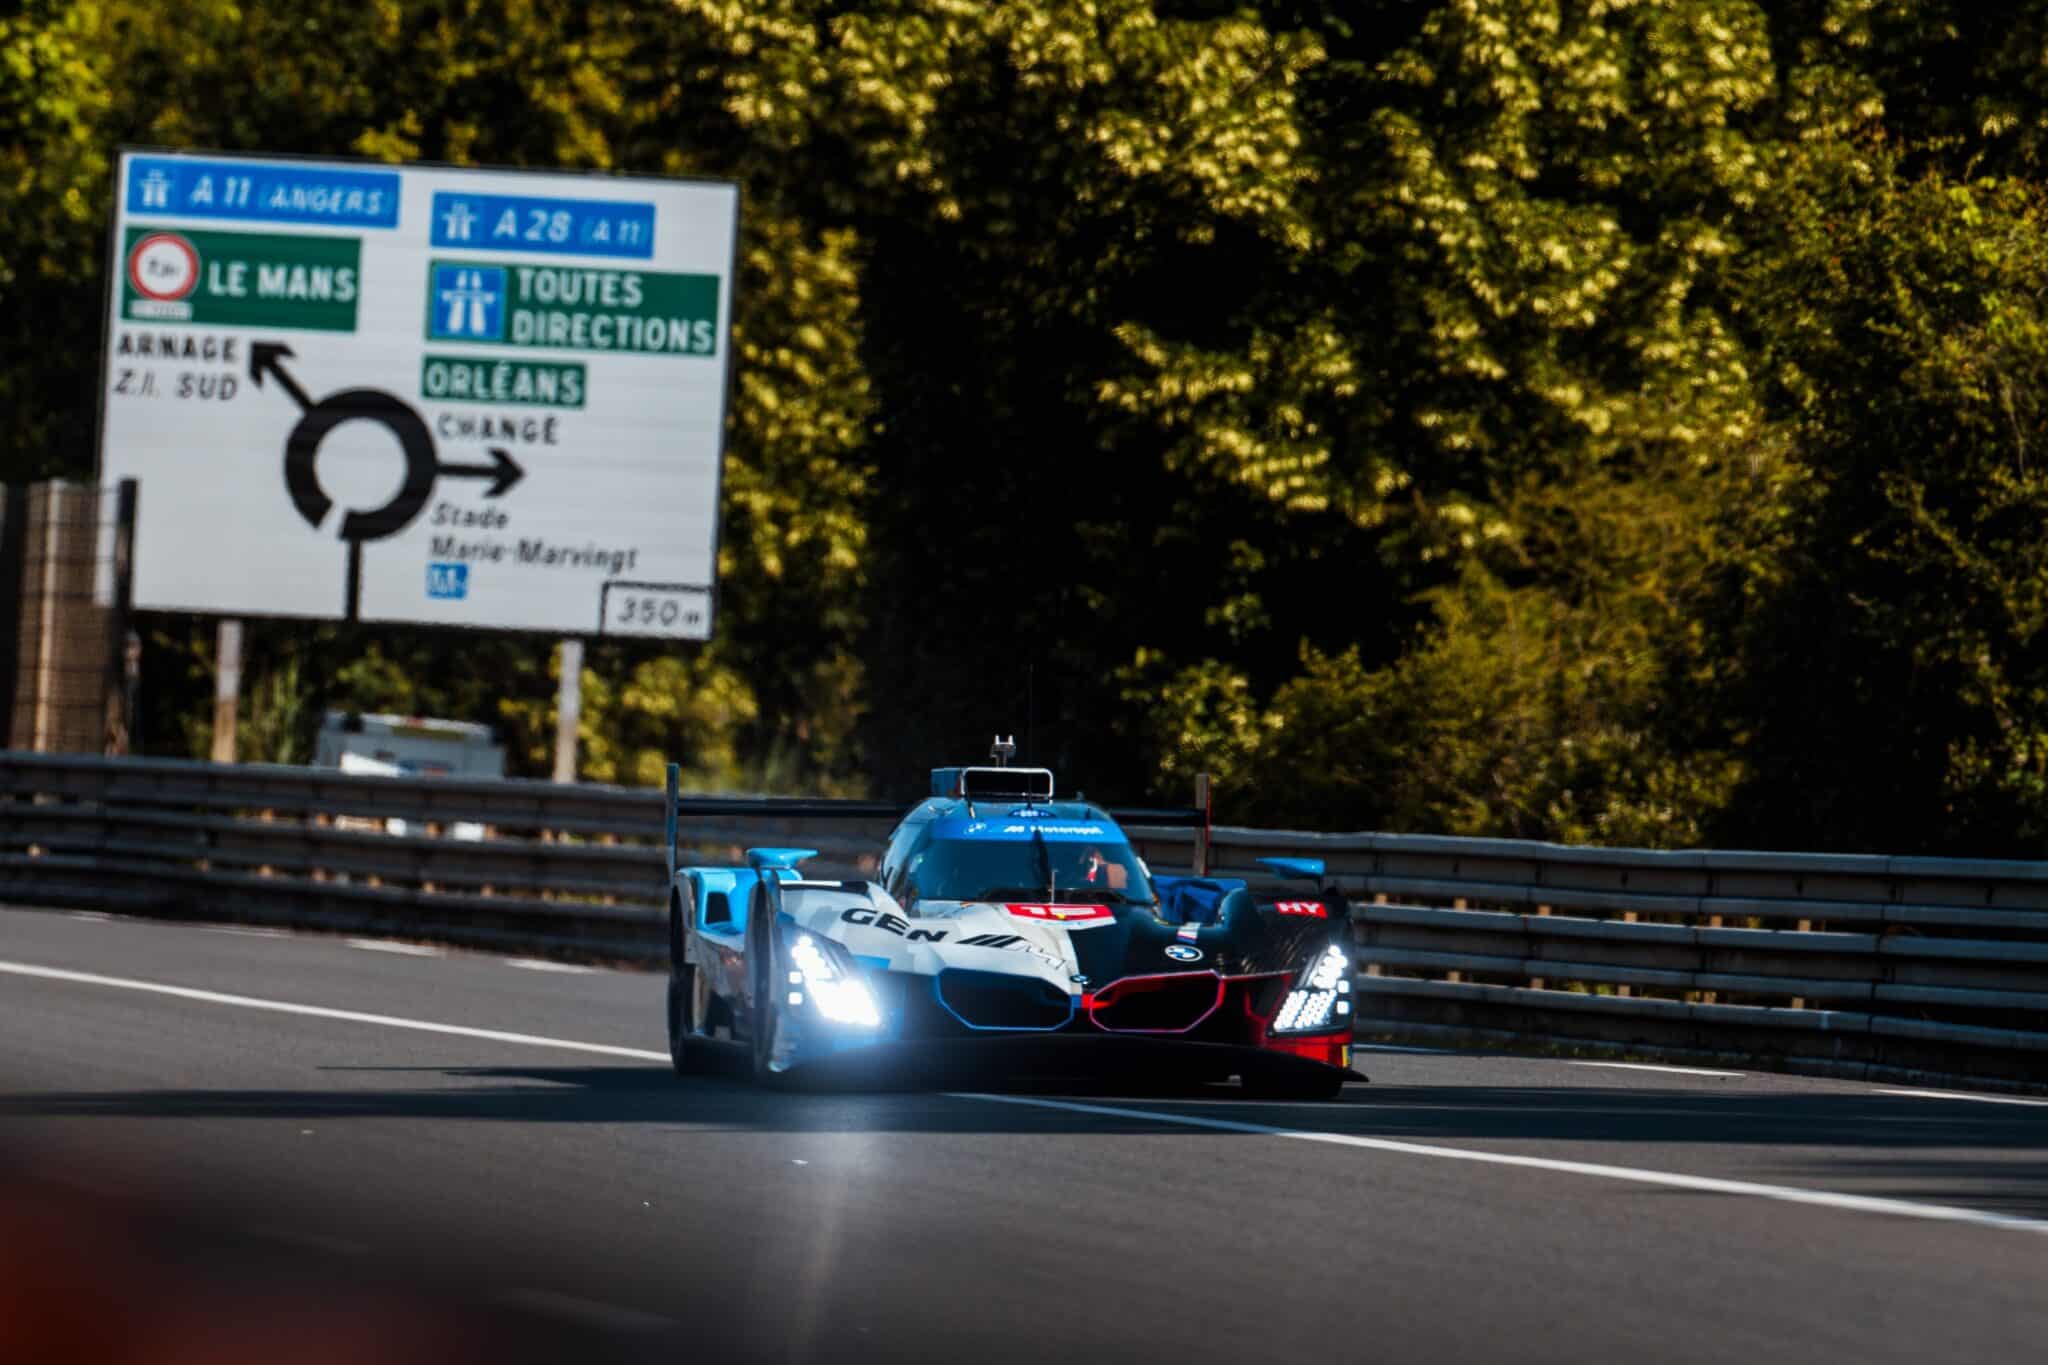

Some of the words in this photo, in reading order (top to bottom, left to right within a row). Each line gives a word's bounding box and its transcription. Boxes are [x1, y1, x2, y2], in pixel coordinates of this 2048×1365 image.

[208, 261, 248, 296] LE
[257, 264, 356, 303] MANS
[516, 268, 643, 308] TOUTES
[117, 332, 239, 364] ARNAGE
[512, 310, 713, 356] DIRECTIONS
[176, 371, 238, 400] SUD
[425, 358, 583, 404] ORLÉANS
[430, 503, 510, 530] Stade
[618, 597, 679, 627] 350
[841, 908, 948, 942] GEN
